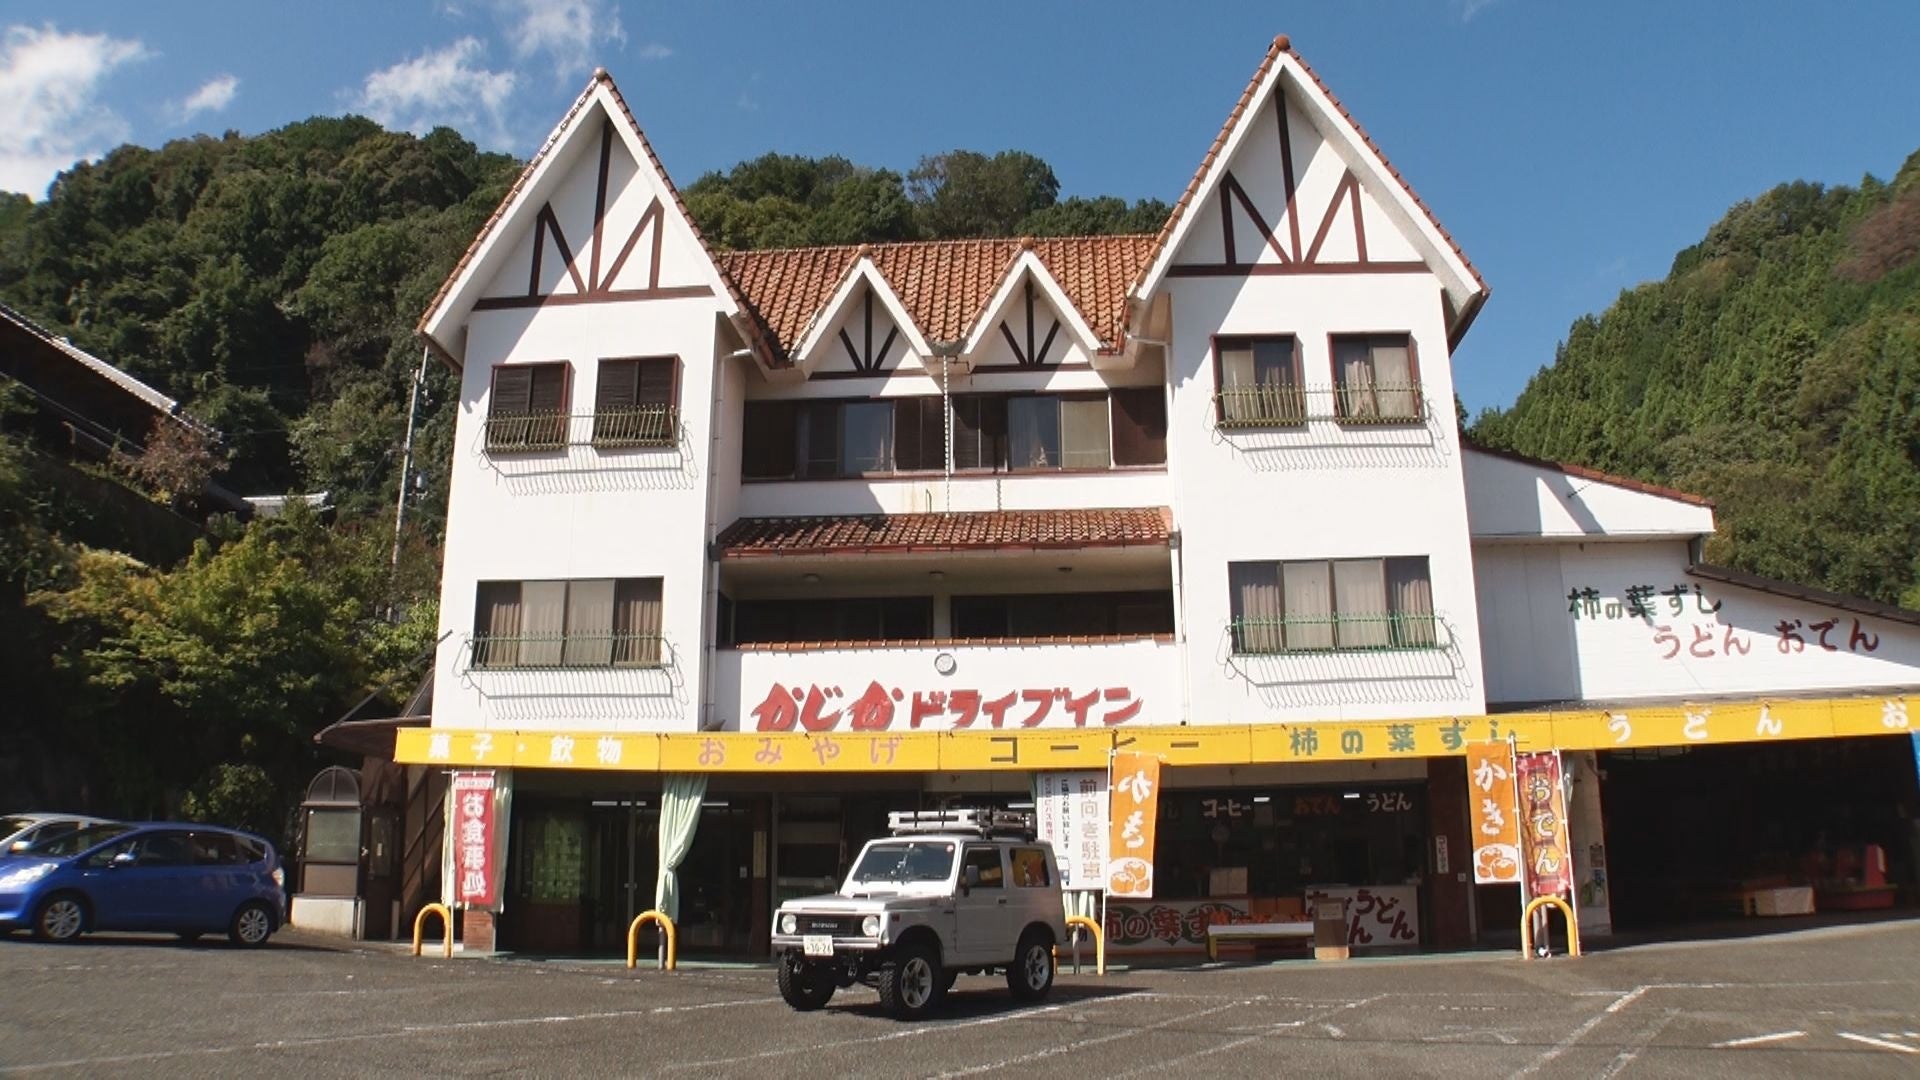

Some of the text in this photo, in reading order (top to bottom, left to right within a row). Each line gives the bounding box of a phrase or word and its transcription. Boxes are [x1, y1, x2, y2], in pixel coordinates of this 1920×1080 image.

[1568, 584, 1722, 621] 柿の葉ずし
[1653, 617, 1880, 660] うどん おでん
[751, 681, 1144, 733] かじかドライブイン
[698, 737, 902, 767] おみやげ
[1607, 709, 1783, 743] うどん
[1881, 700, 1909, 728] お
[1202, 798, 1251, 818] コーヒー
[1366, 792, 1413, 812] うどん
[1472, 758, 1508, 836] かき
[1528, 774, 1560, 875] おでん
[1355, 889, 1417, 940] うどん
